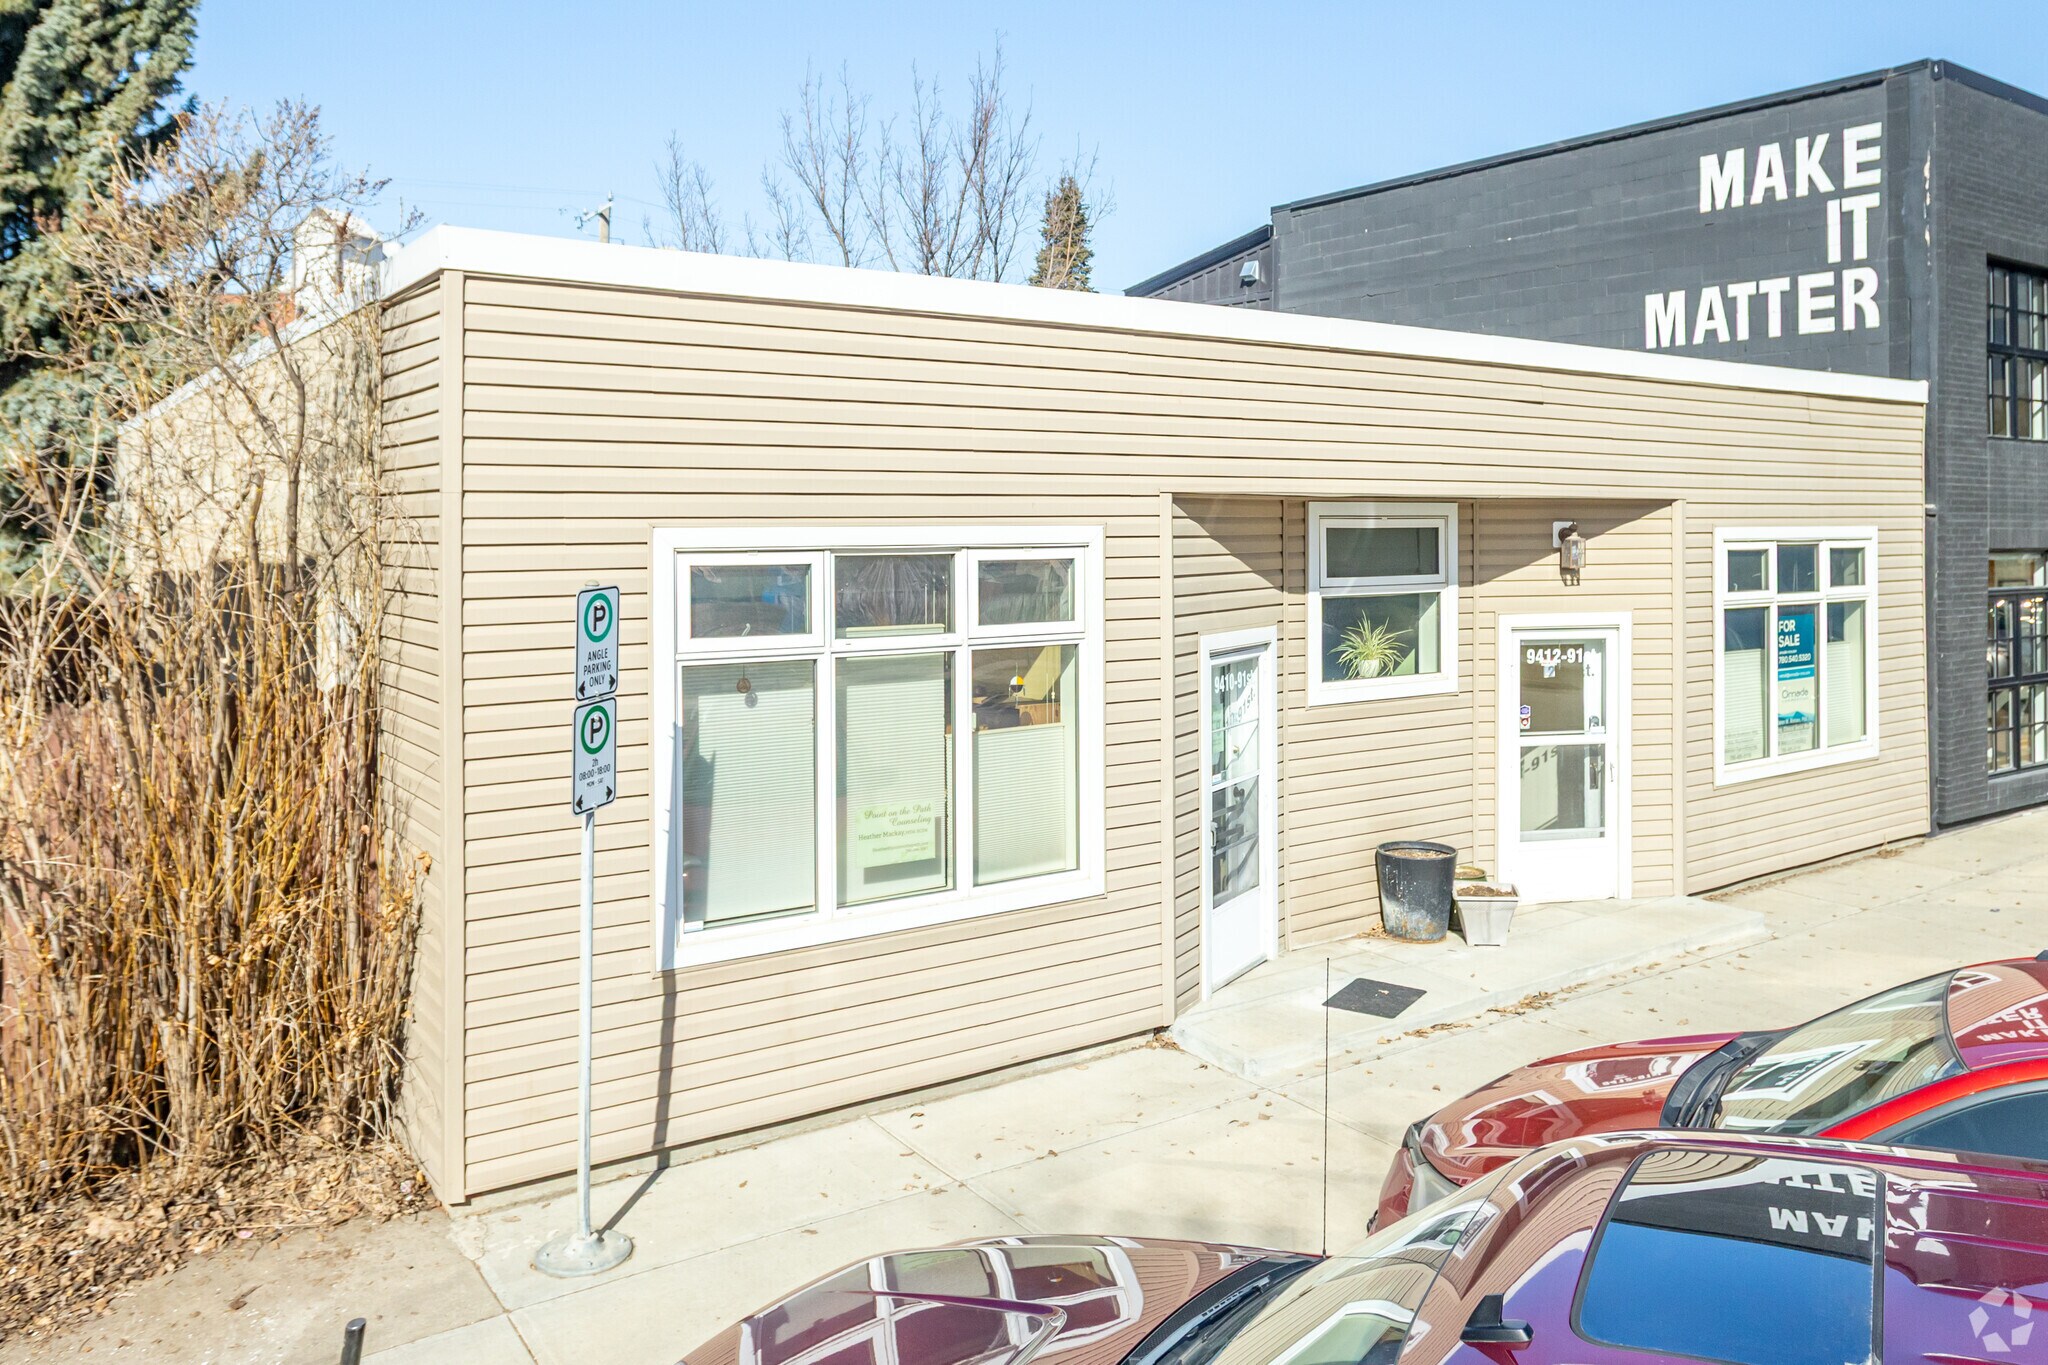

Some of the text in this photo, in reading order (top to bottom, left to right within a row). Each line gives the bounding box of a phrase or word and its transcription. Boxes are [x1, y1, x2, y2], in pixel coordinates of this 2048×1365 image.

[1699, 121, 1882, 214] MAKE
[1826, 192, 1881, 264] IT
[1645, 266, 1880, 349] MATTER
[593, 603, 606, 632] P
[1778, 619, 1796, 633] FOR
[1778, 634, 1800, 648] SALE
[587, 648, 608, 661] ANGLE
[583, 659, 612, 677] PARKING
[589, 673, 606, 688] ONLY
[590, 715, 603, 744] P
[591, 758, 599, 768] 2h
[900, 807, 909, 815] the
[912, 803, 931, 812] Path
